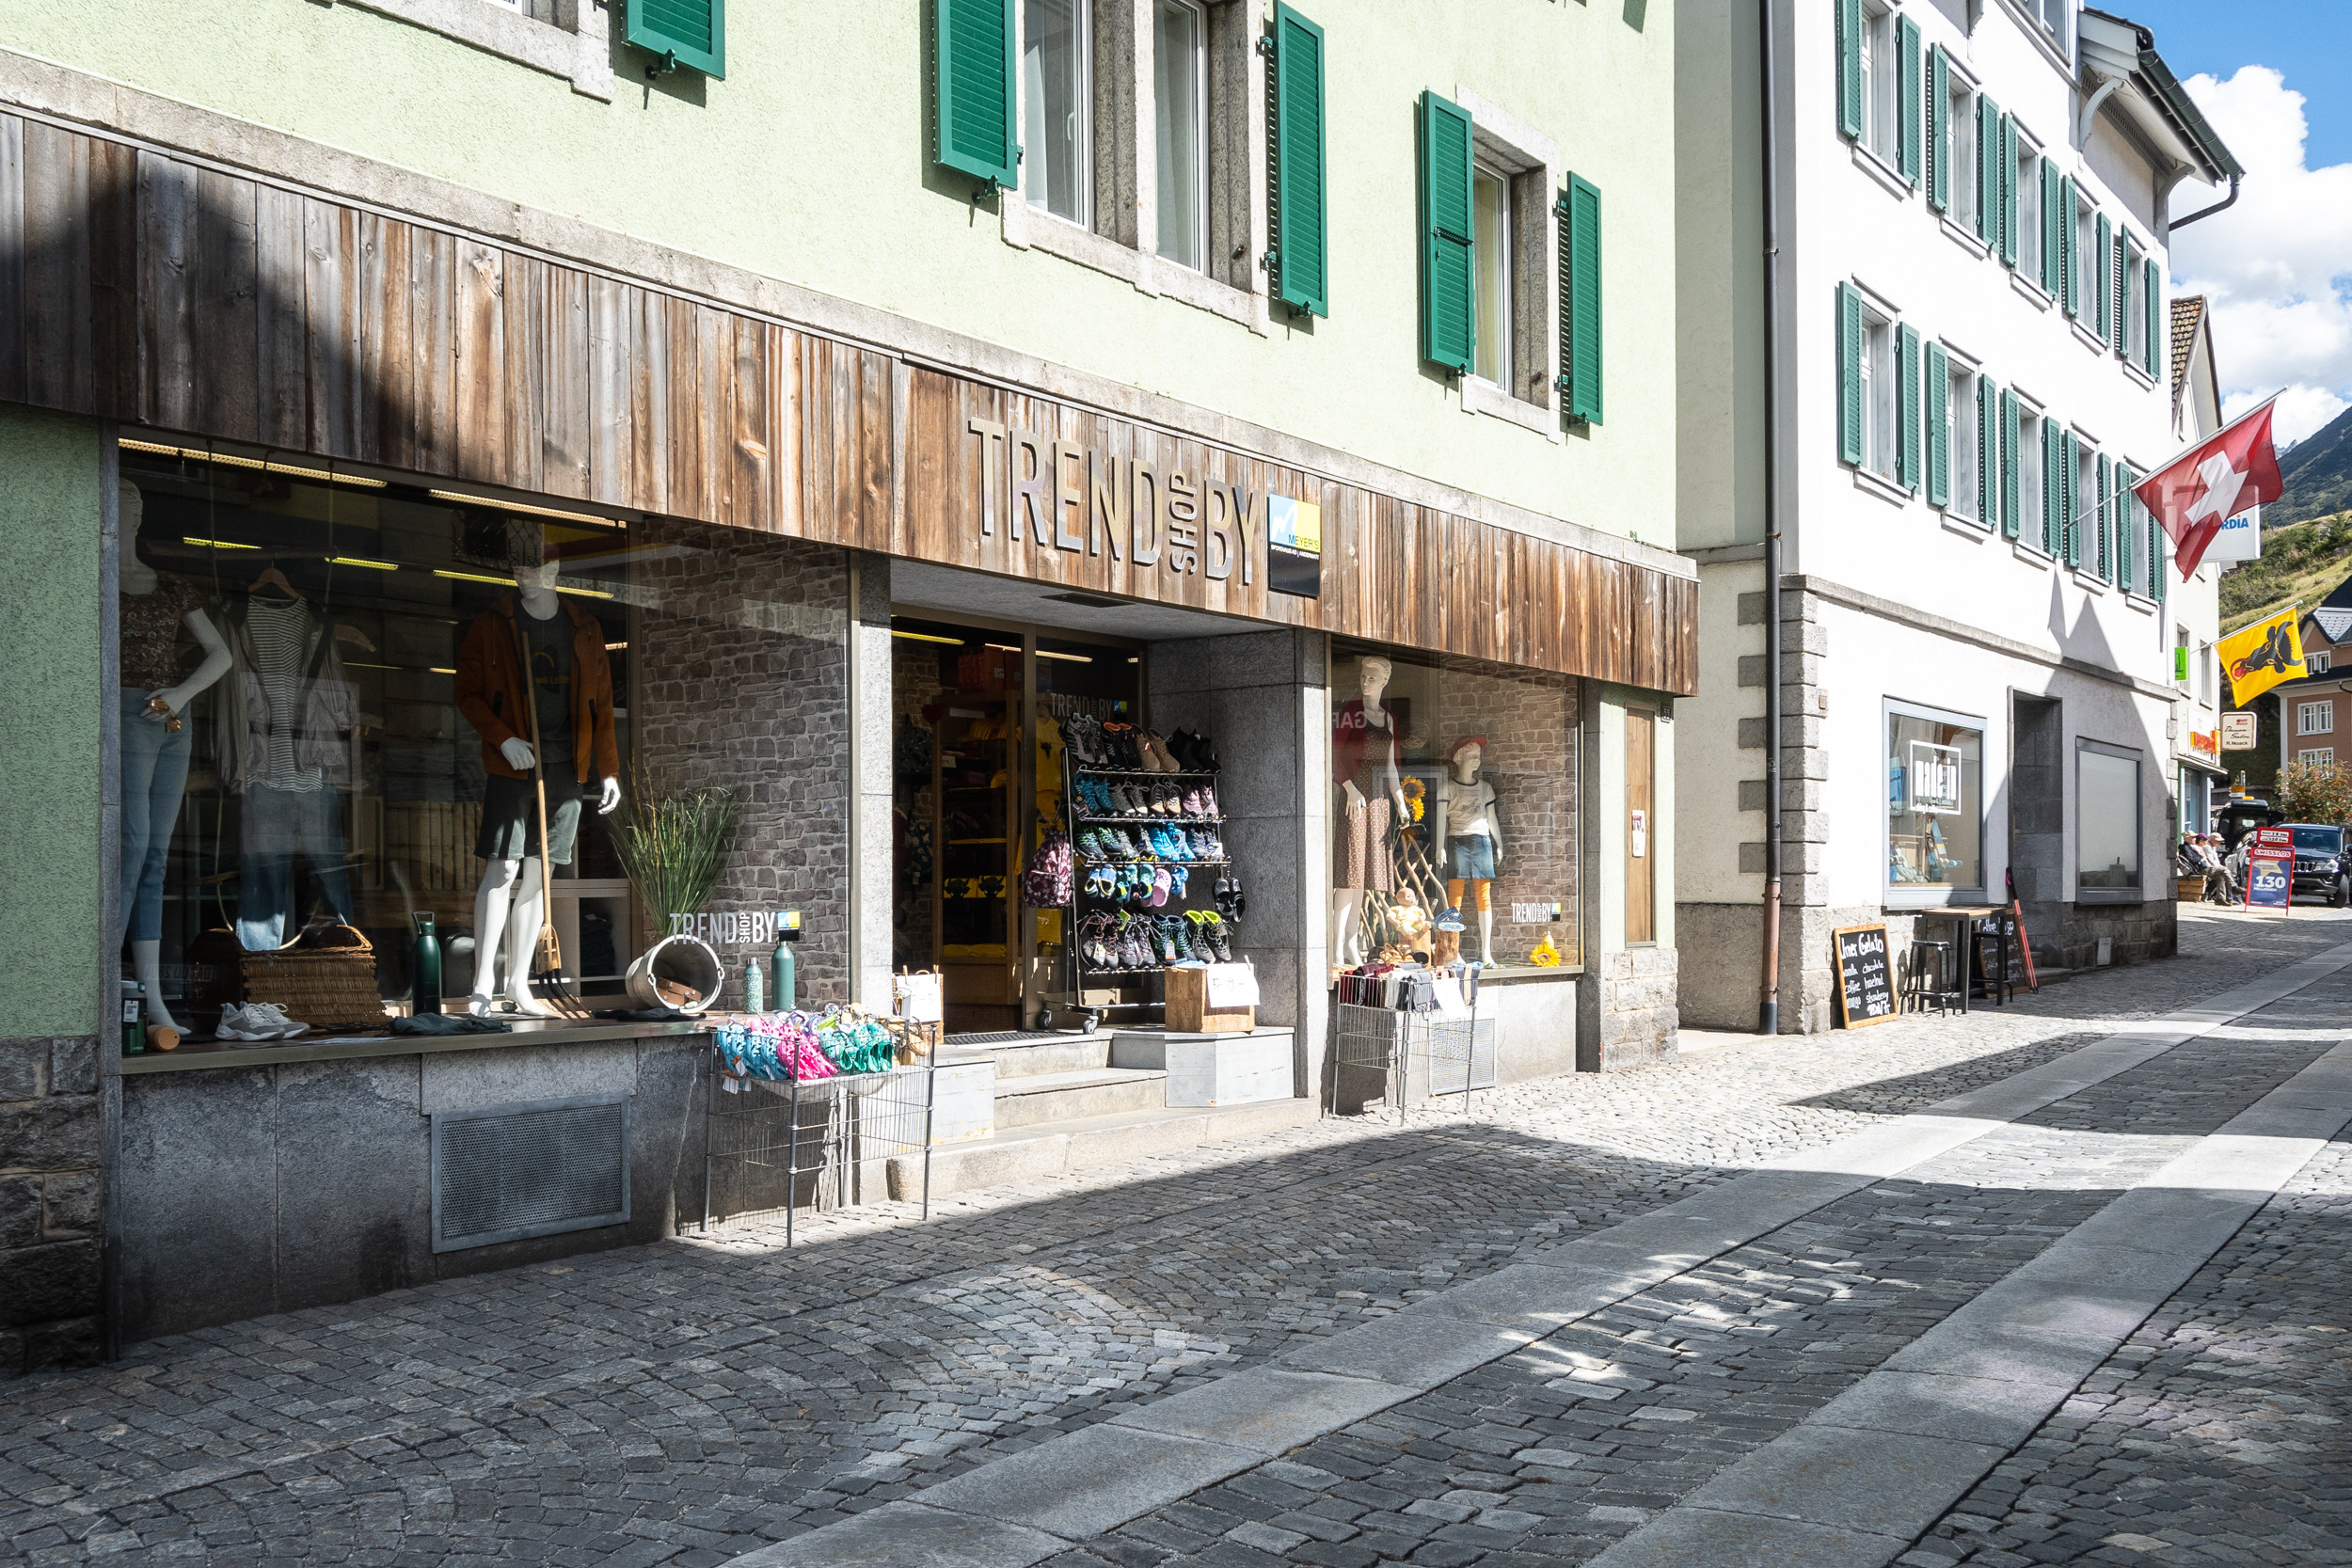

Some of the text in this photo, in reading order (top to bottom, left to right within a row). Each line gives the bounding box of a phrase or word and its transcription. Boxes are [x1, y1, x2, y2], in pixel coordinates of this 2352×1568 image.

[969, 417, 1259, 584] TREND SHOP BY
[1289, 534, 1319, 550] MEYER'S
[2254, 849, 2291, 858] SWISSLOS
[2255, 876, 2286, 889] 130
[1511, 903, 1536, 923] TREND
[1543, 903, 1551, 922] BY
[670, 911, 775, 945] TREND SHOP BY
[1858, 933, 1883, 956] Gelato
[1845, 980, 1861, 994] coffee
